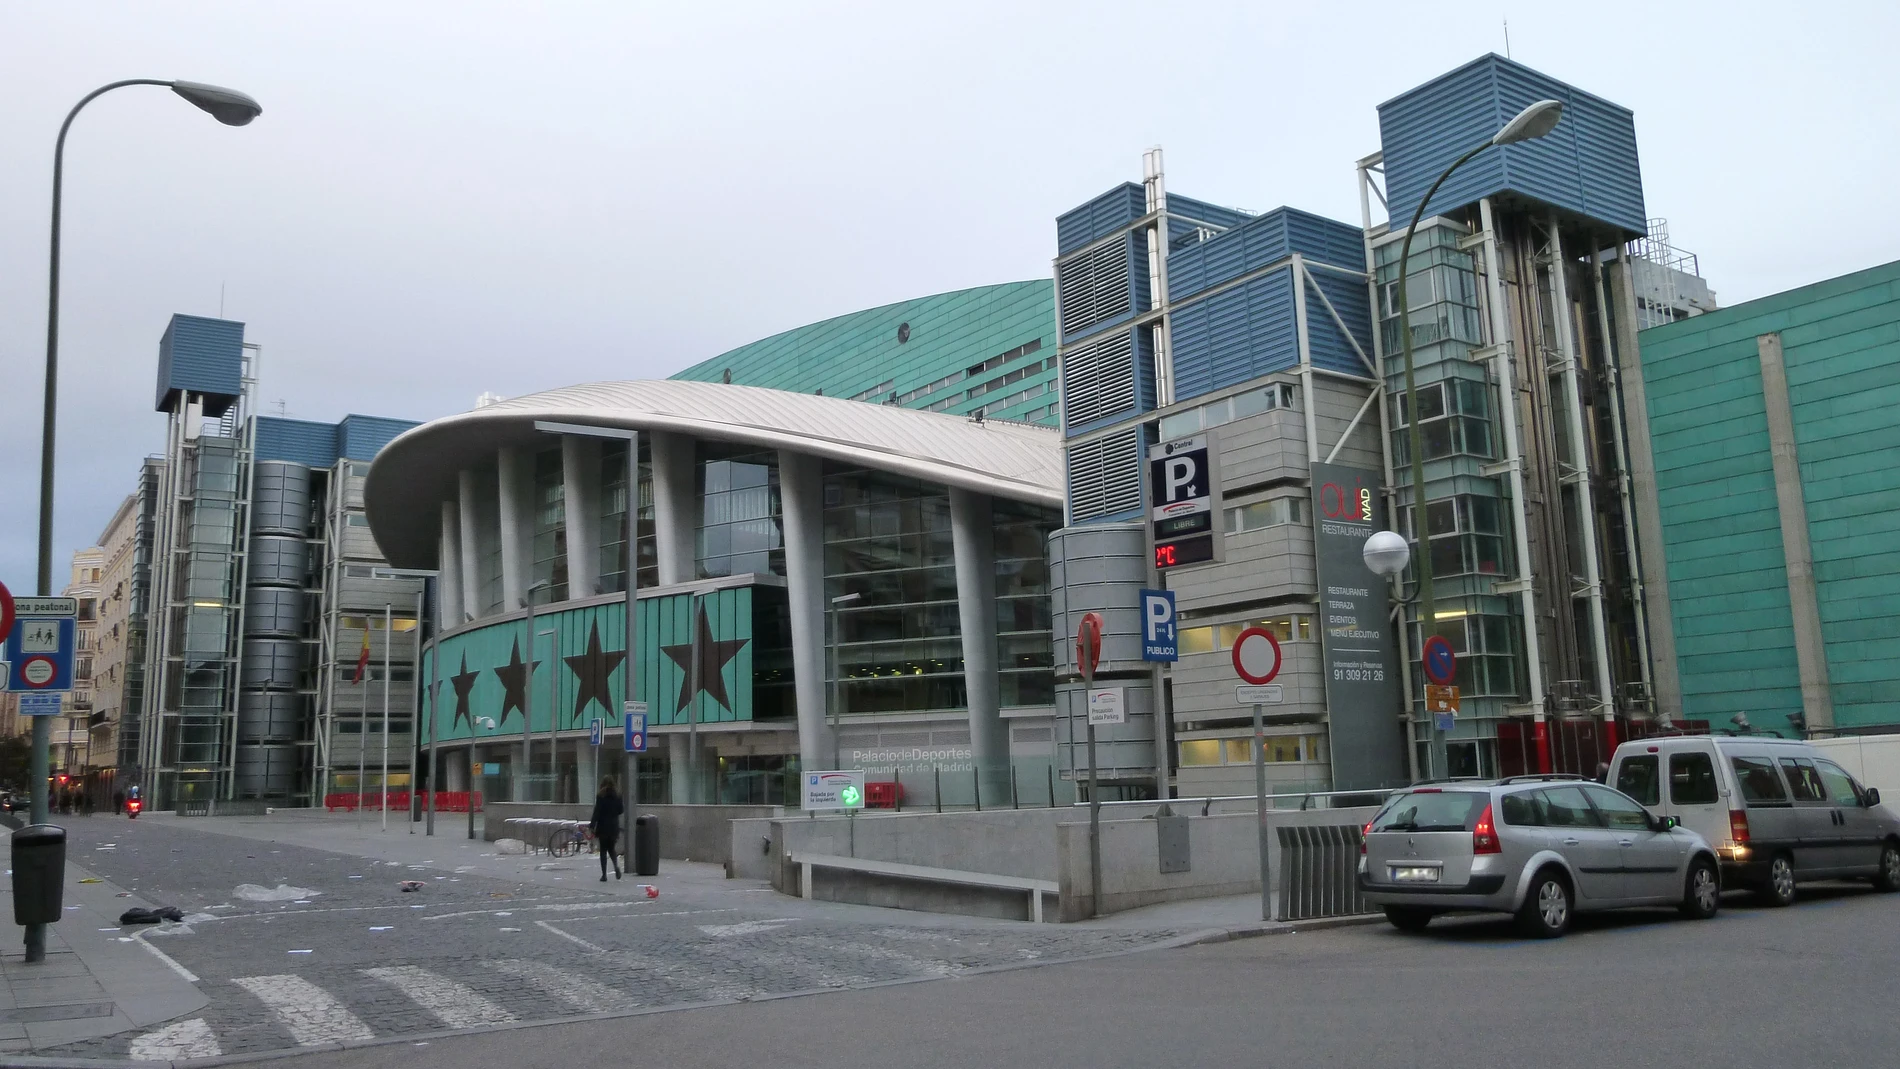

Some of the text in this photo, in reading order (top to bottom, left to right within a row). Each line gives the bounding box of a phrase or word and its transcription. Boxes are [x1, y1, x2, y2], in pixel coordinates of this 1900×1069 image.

[1174, 439, 1193, 450] Central
[1165, 456, 1196, 502] P
[1360, 488, 1372, 521] MAD
[1173, 519, 1196, 530] LIBRE
[1322, 524, 1373, 538] RESTAURANTE
[1327, 586, 1369, 597] RESTAURANTE
[34, 602, 72, 613] peatonal
[1328, 600, 1355, 610] TERRAZA
[1146, 595, 1172, 641] P
[1329, 615, 1357, 625] EVENTOS
[1348, 630, 1380, 639] EJECUTIVO
[1333, 669, 1384, 681] 91 309 21 26
[592, 722, 598, 742] P
[916, 762, 930, 772] de
[933, 762, 973, 773] Madrid
